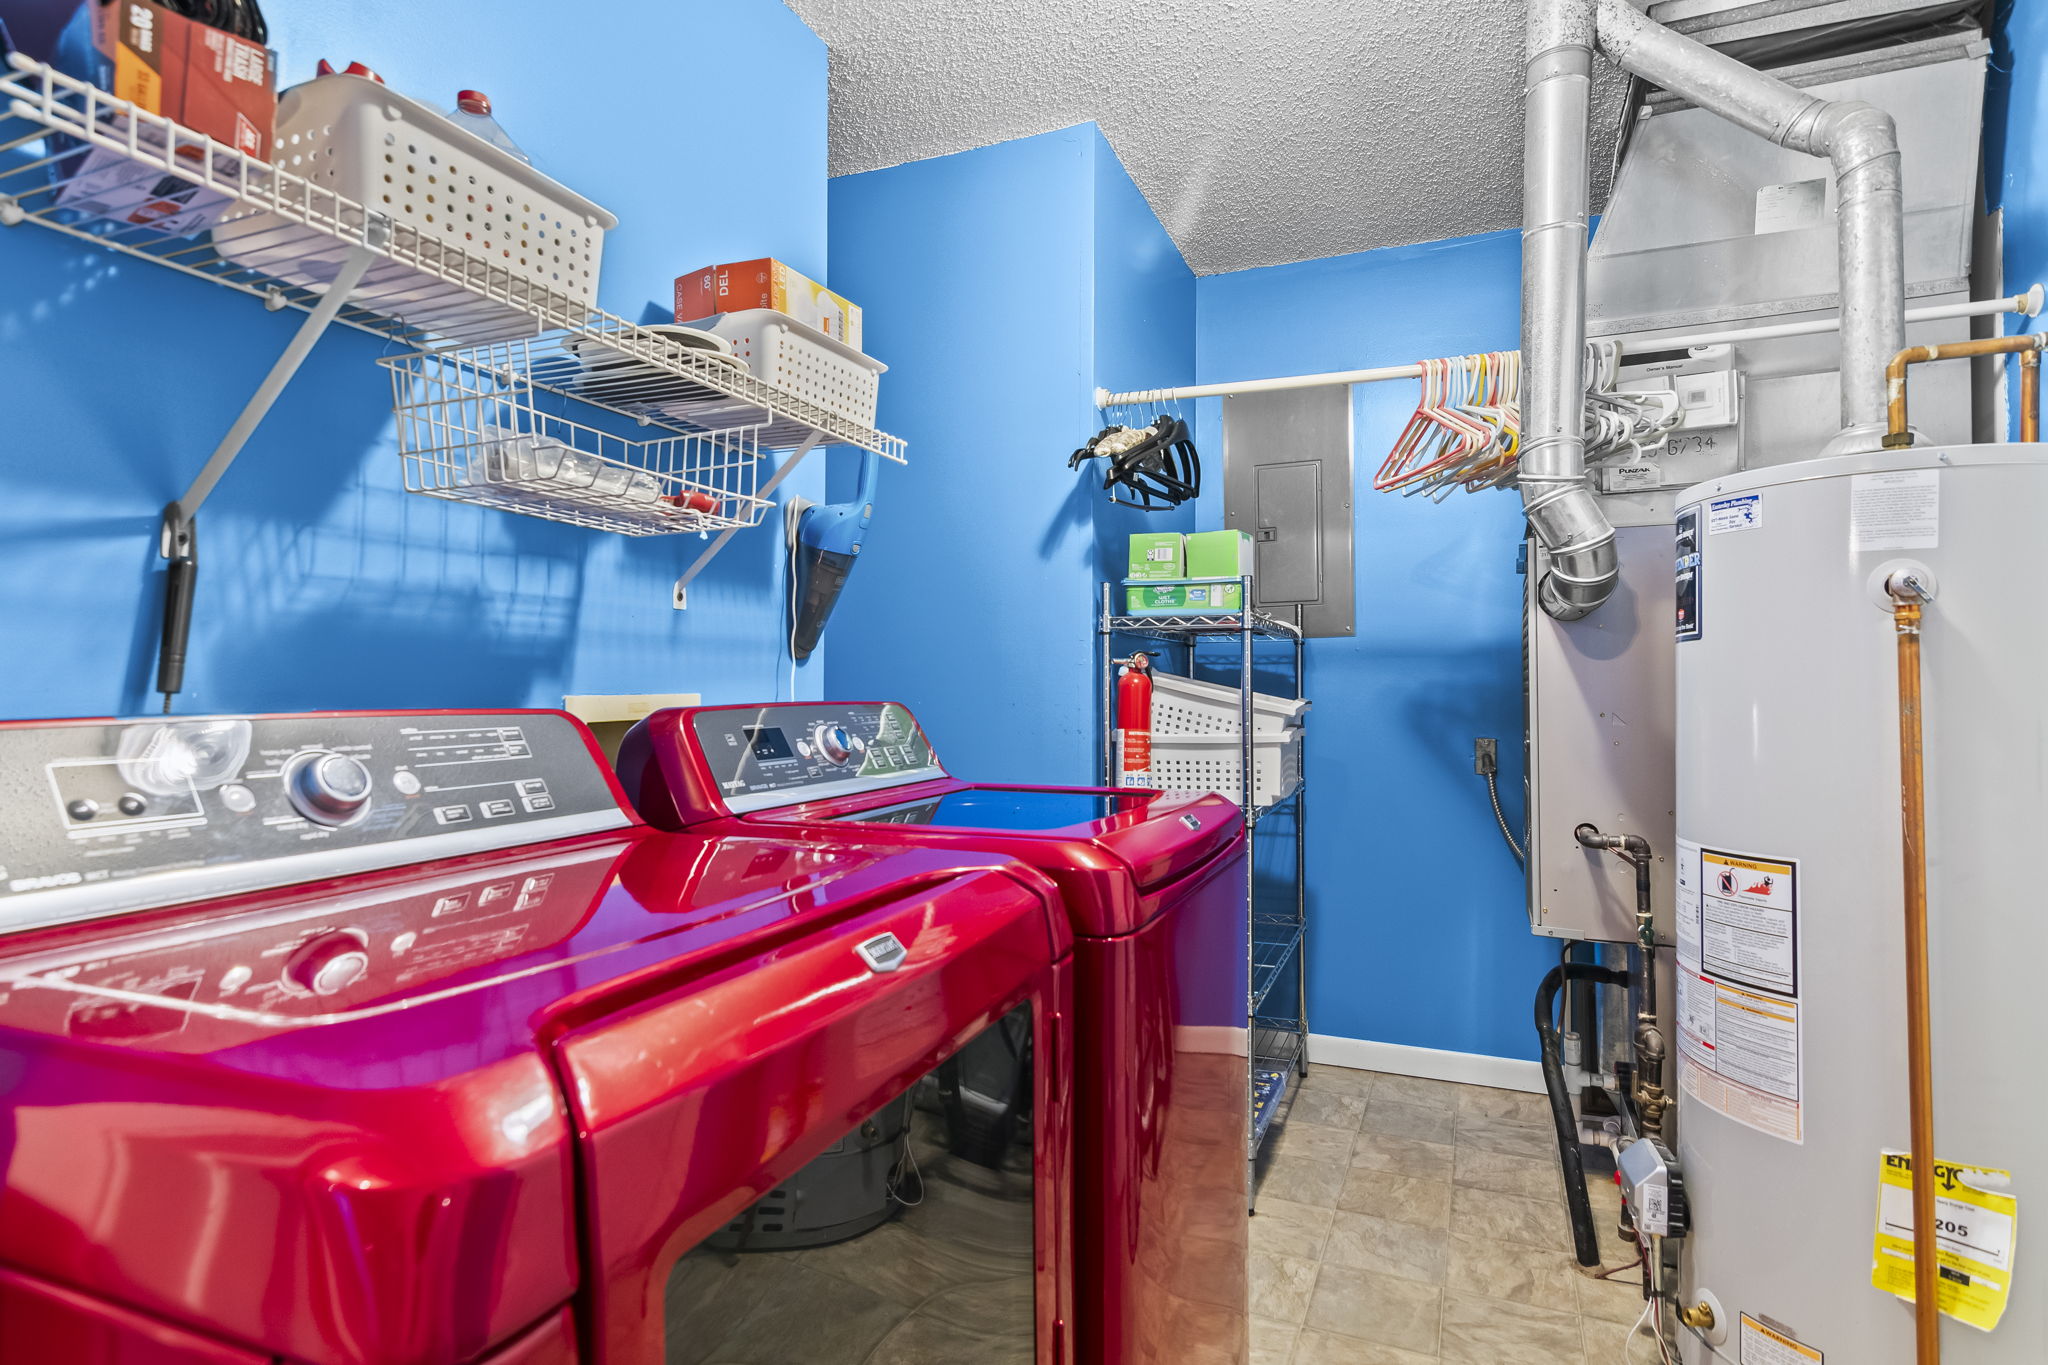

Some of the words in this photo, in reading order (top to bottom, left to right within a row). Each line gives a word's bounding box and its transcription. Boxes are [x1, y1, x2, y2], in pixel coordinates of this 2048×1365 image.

[129, 3, 153, 29] 20
[719, 269, 729, 297] DEL
[676, 282, 684, 312] CASE
[1729, 860, 1758, 870] WARNING
[1764, 1328, 1798, 1350] WARNING
